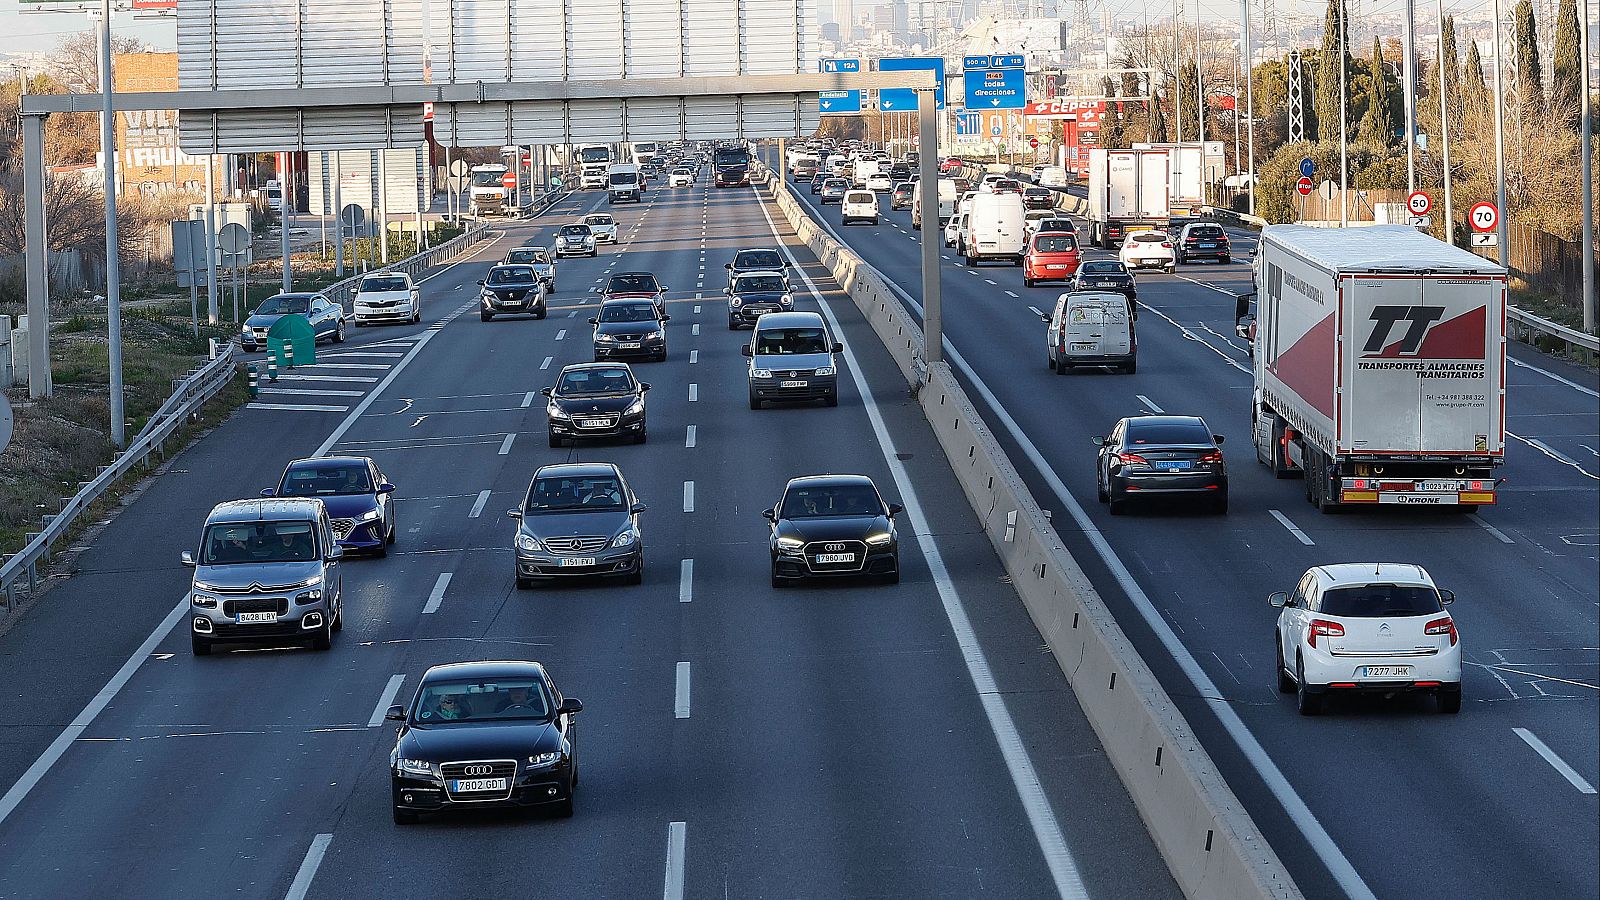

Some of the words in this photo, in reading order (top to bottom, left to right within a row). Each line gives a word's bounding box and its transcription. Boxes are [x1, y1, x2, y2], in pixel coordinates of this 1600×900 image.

[1412, 199, 1427, 208] 50
[1476, 212, 1492, 222] 70
[1362, 305, 1447, 355] TT
[1358, 362, 1425, 371] TRANSPORTES
[1428, 363, 1485, 371] ALMACENES
[1416, 371, 1485, 379] TRANSITARIOS
[563, 558, 578, 566] 1151
[241, 613, 260, 621] 8428
[261, 613, 276, 621] LRV
[1368, 667, 1389, 676] 7277
[1392, 667, 1408, 676] JHK
[459, 781, 483, 790] 7802
[486, 780, 503, 789] GDT
